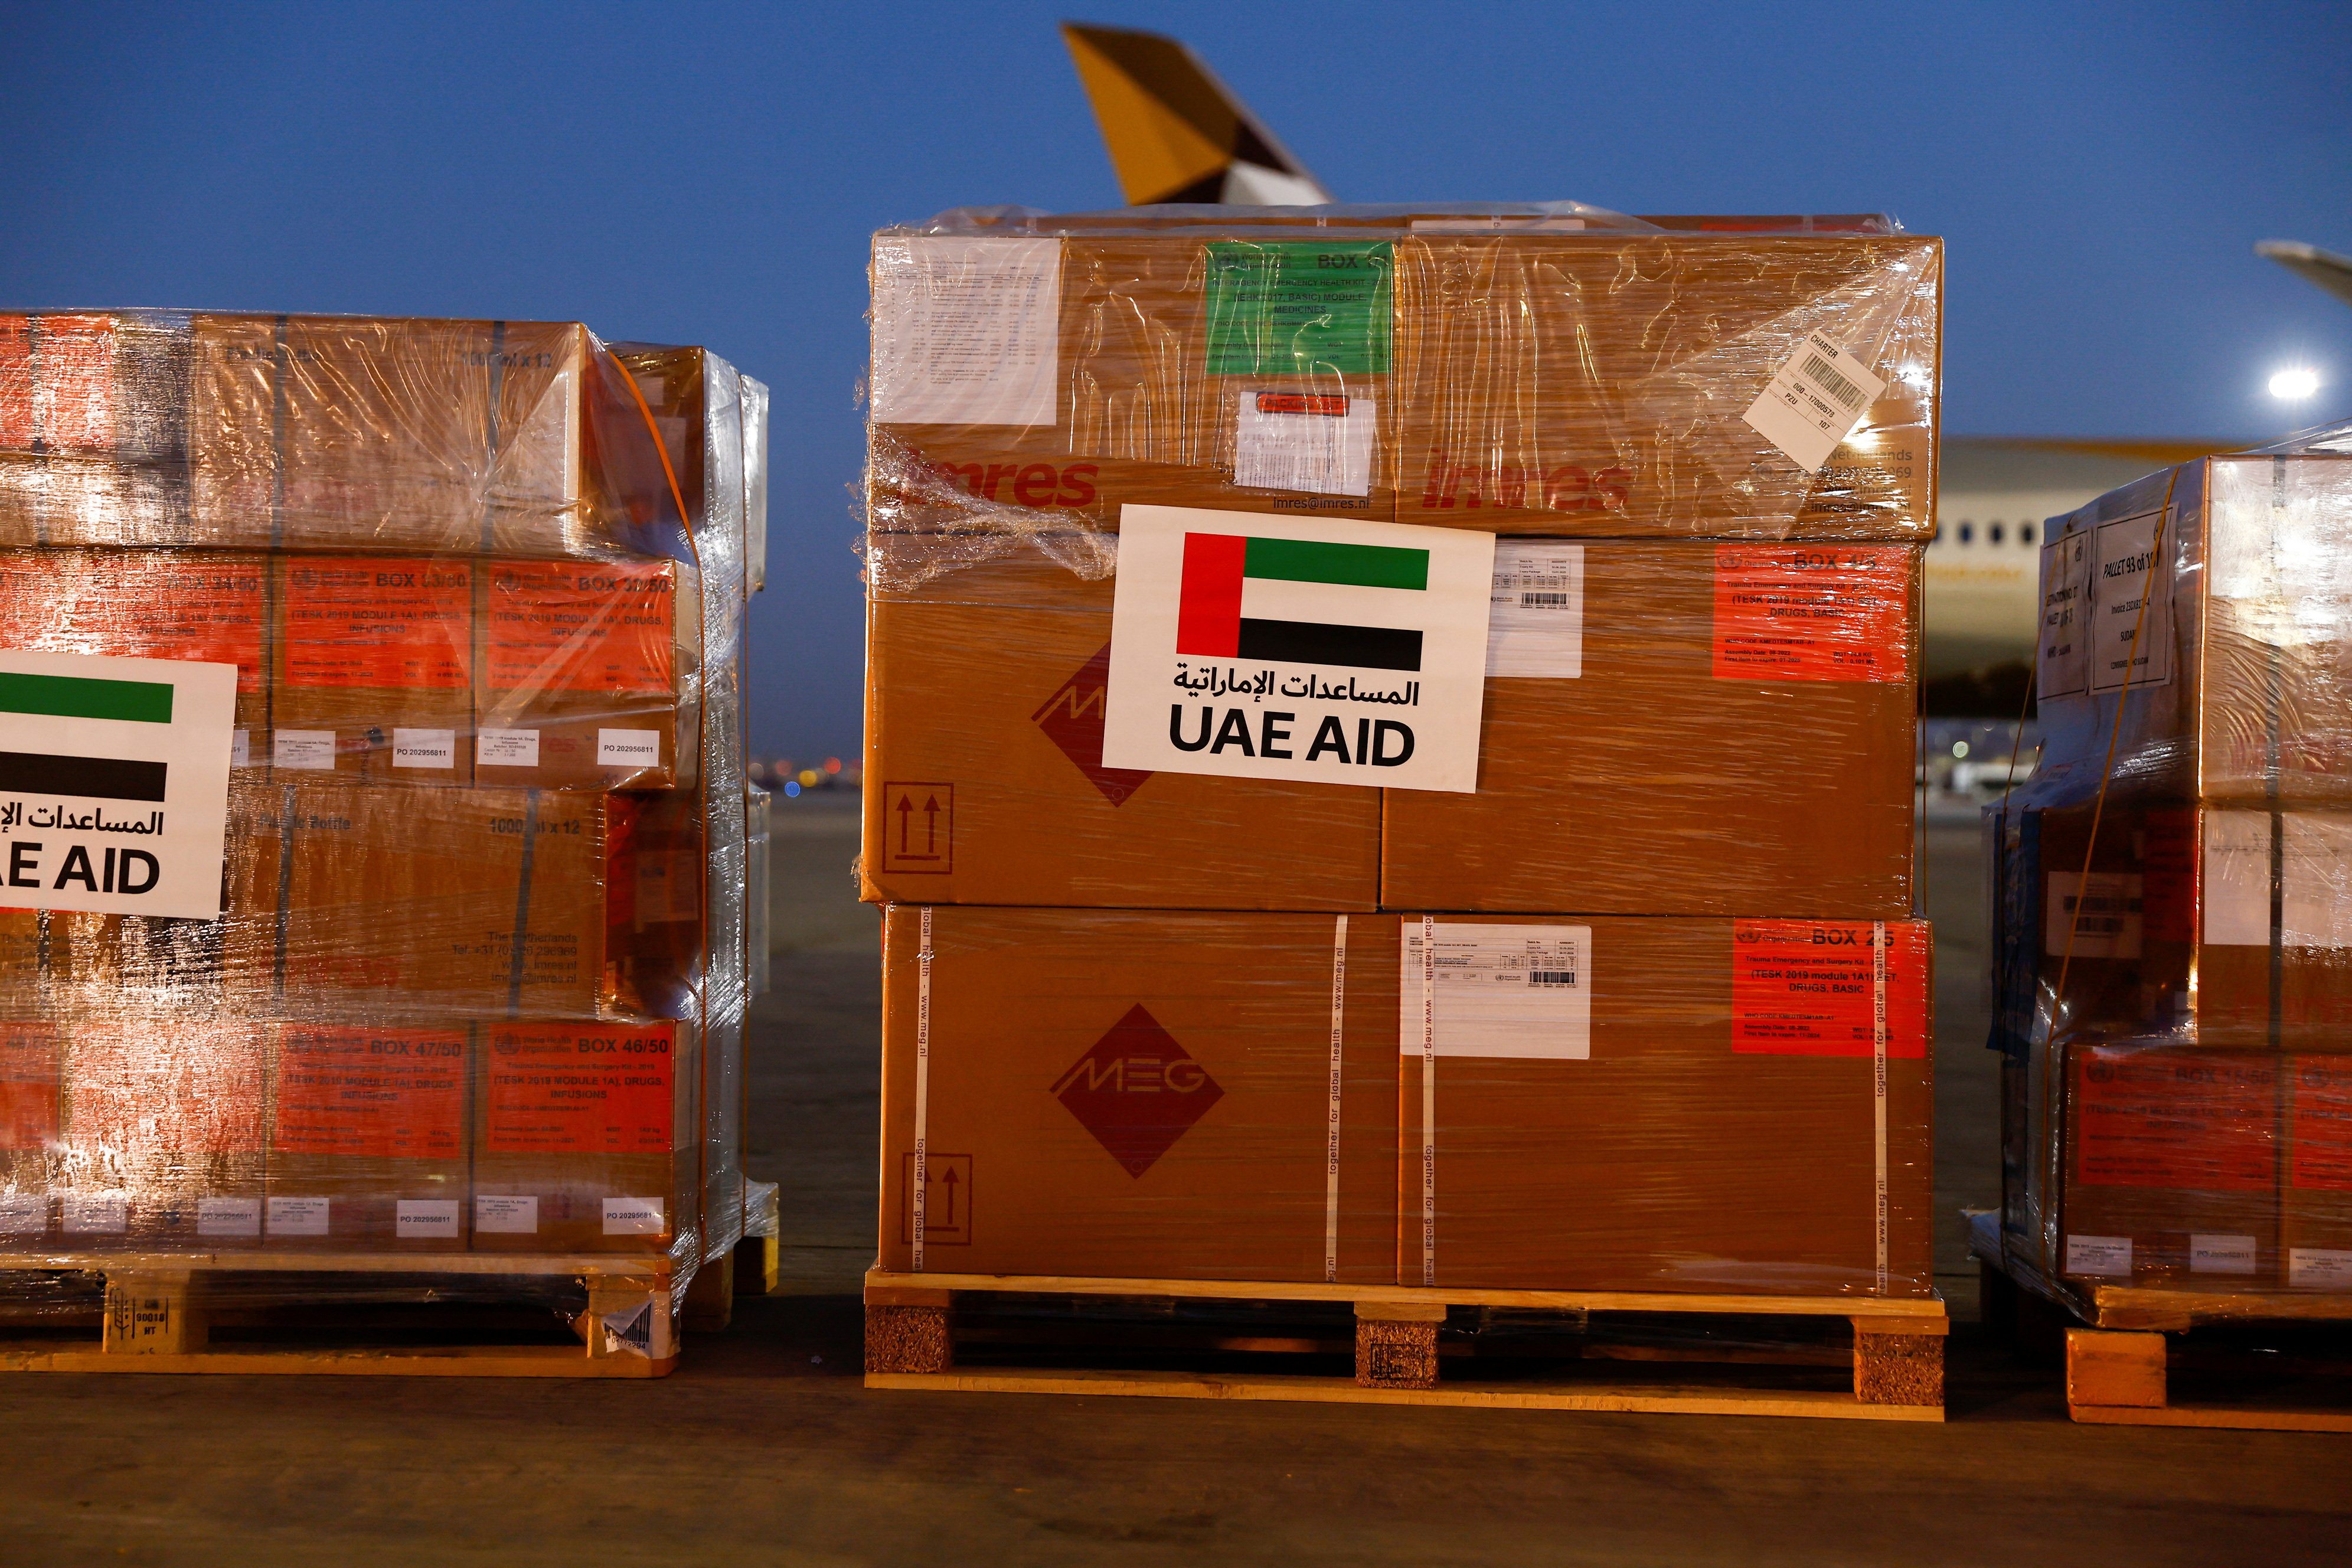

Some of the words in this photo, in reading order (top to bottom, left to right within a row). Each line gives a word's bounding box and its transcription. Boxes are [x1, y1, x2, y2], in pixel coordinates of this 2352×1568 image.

[1318, 254, 1358, 269] BOX
[1234, 293, 1260, 302] (IEHK
[1288, 293, 1321, 302] BASIC)
[1810, 334, 1838, 359] CHARTER
[1265, 399, 1314, 408] PACKING
[1785, 393, 1798, 405] PZU
[1819, 420, 1830, 430] 107
[1422, 447, 1632, 509] imres
[1273, 498, 1369, 509] imres@imres.nl
[1794, 554, 1838, 570] BOX
[2103, 558, 2125, 579] PALLET
[2126, 557, 2135, 573] 93
[2137, 553, 2145, 571] of
[376, 573, 415, 587] BOX
[421, 574, 466, 587] 33/50
[579, 577, 616, 591] BOX
[623, 578, 668, 593] 32/50
[1732, 596, 1763, 605] (TESK
[1767, 596, 1789, 604] 2019
[292, 611, 324, 620] (TESK
[326, 611, 349, 619] 2019
[494, 612, 525, 622] (TESK
[554, 615, 598, 623] MODULE
[624, 616, 665, 626] DRUGS,
[1770, 609, 1809, 618] DRUGS,
[1813, 609, 1845, 618] BASIC
[349, 625, 406, 633] INFUSIONS
[551, 628, 607, 637] INFUSIONS
[1173, 662, 1275, 703] الإماراتية
[1280, 673, 1419, 707] المساعدات
[1169, 704, 1295, 760] UAE
[1305, 715, 1415, 767] AID
[28, 805, 164, 835] المساعدات
[489, 819, 523, 833] 1000
[550, 824, 557, 834] x
[563, 821, 580, 834] 12
[53, 845, 160, 894] AID
[922, 906, 931, 937] global
[488, 932, 509, 943] The
[1812, 929, 1857, 946] BOX
[452, 946, 471, 955] Tel.
[475, 946, 494, 956] +31
[536, 946, 577, 956] 296969
[922, 945, 930, 976] health
[1426, 948, 1434, 981] health
[1773, 956, 1809, 965] Emergency
[1875, 949, 1883, 982] health
[1335, 948, 1345, 1010] www.meg.nl
[1751, 970, 1782, 979] (TESK
[1786, 971, 1808, 979] 2019
[1811, 971, 1848, 981] module
[1789, 984, 1829, 993] DRUGS,
[1832, 984, 1864, 993] BASIC
[919, 995, 927, 1057] www.meg.nl
[1423, 999, 1433, 1062] www.meg.nl
[371, 1040, 410, 1054] BOX
[415, 1043, 460, 1057] 47/50
[578, 1038, 618, 1053] BOX
[622, 1039, 668, 1053] 46/50
[1332, 1029, 1340, 1061] health
[319, 1076, 342, 1084] 2019
[345, 1077, 390, 1087] MODULE
[494, 1076, 525, 1085] (TESK
[528, 1076, 551, 1085] 2019
[554, 1077, 598, 1086] MODULE
[625, 1077, 665, 1086] DRUGS,
[1054, 1057, 1205, 1093] MEG
[1877, 1053, 1886, 1097] together
[2175, 1069, 2217, 1083] BOX
[1331, 1069, 1340, 1102] global
[341, 1092, 398, 1100] INFUSIONS
[551, 1090, 607, 1099] INFUSIONS
[916, 1138, 925, 1182] together
[1329, 1131, 1339, 1174] together
[1424, 1145, 1433, 1189] together
[1879, 1181, 1887, 1244] www.meg.nl
[914, 1211, 923, 1242] global
[1424, 1219, 1434, 1250] global
